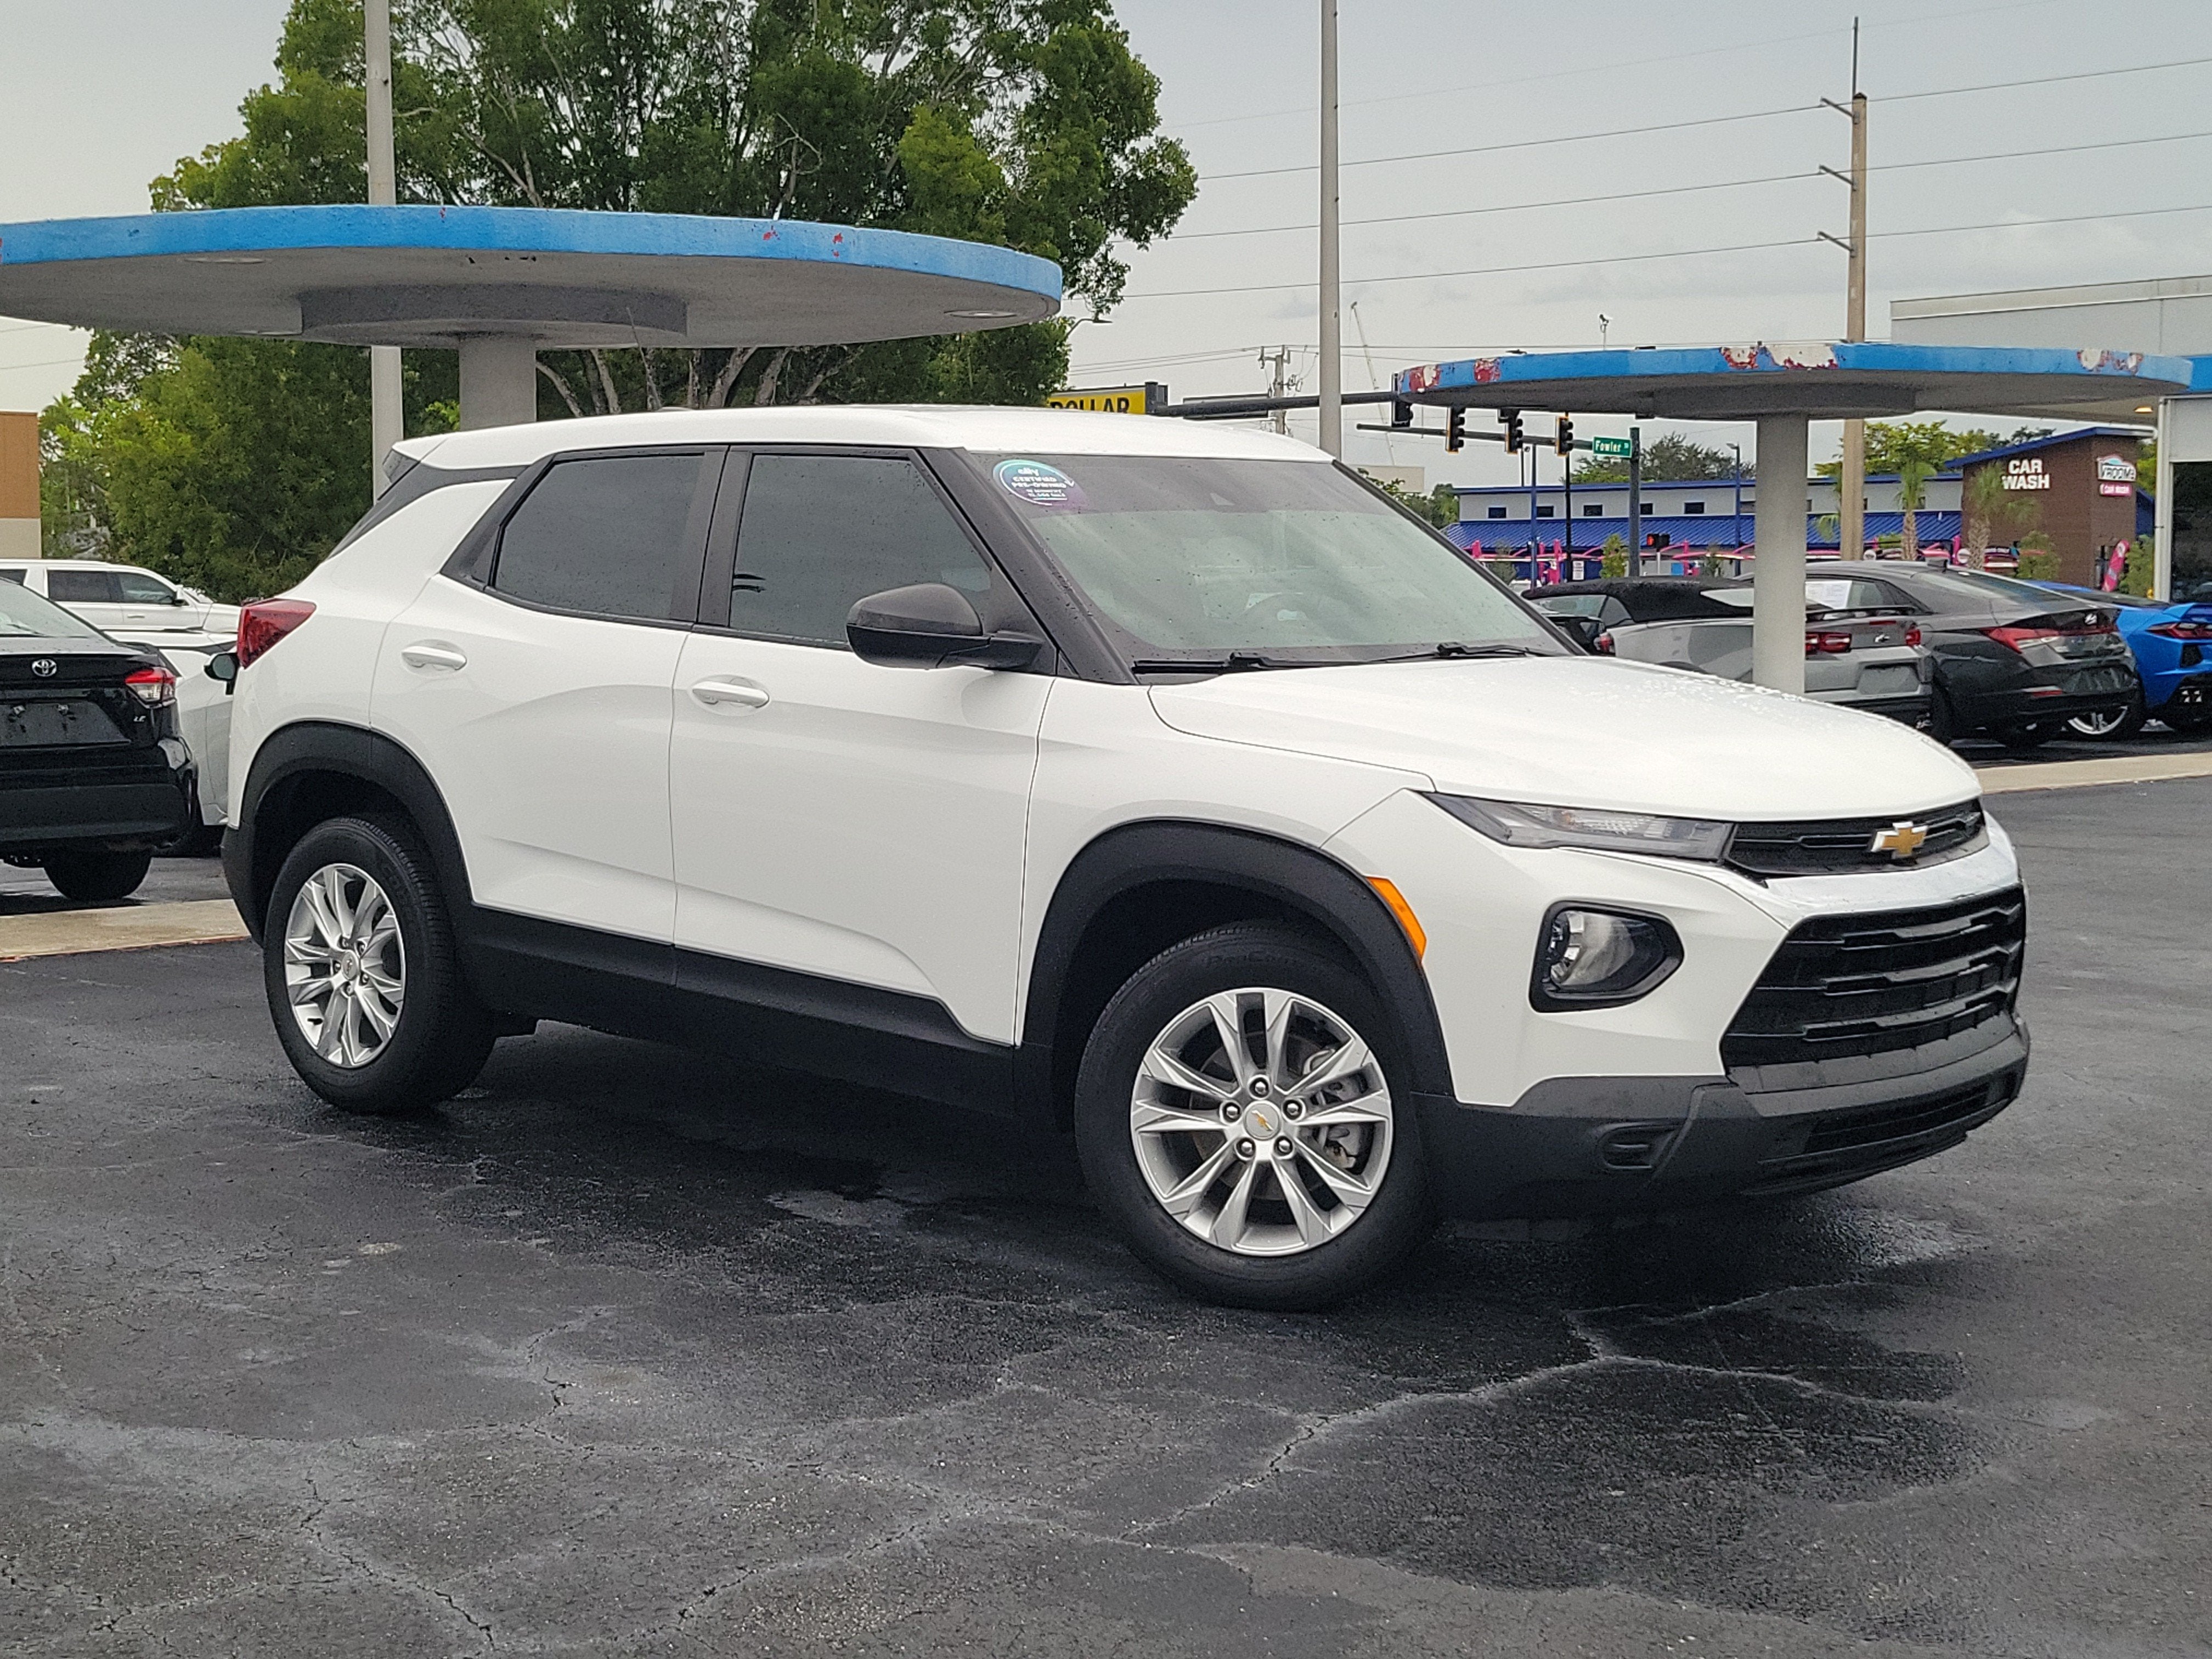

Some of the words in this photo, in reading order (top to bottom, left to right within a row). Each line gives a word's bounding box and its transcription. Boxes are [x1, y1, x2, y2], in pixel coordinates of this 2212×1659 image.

[1595, 440, 1621, 452] Fowler
[2008, 459, 2043, 474] CAR
[2001, 473, 2050, 489] WASH
